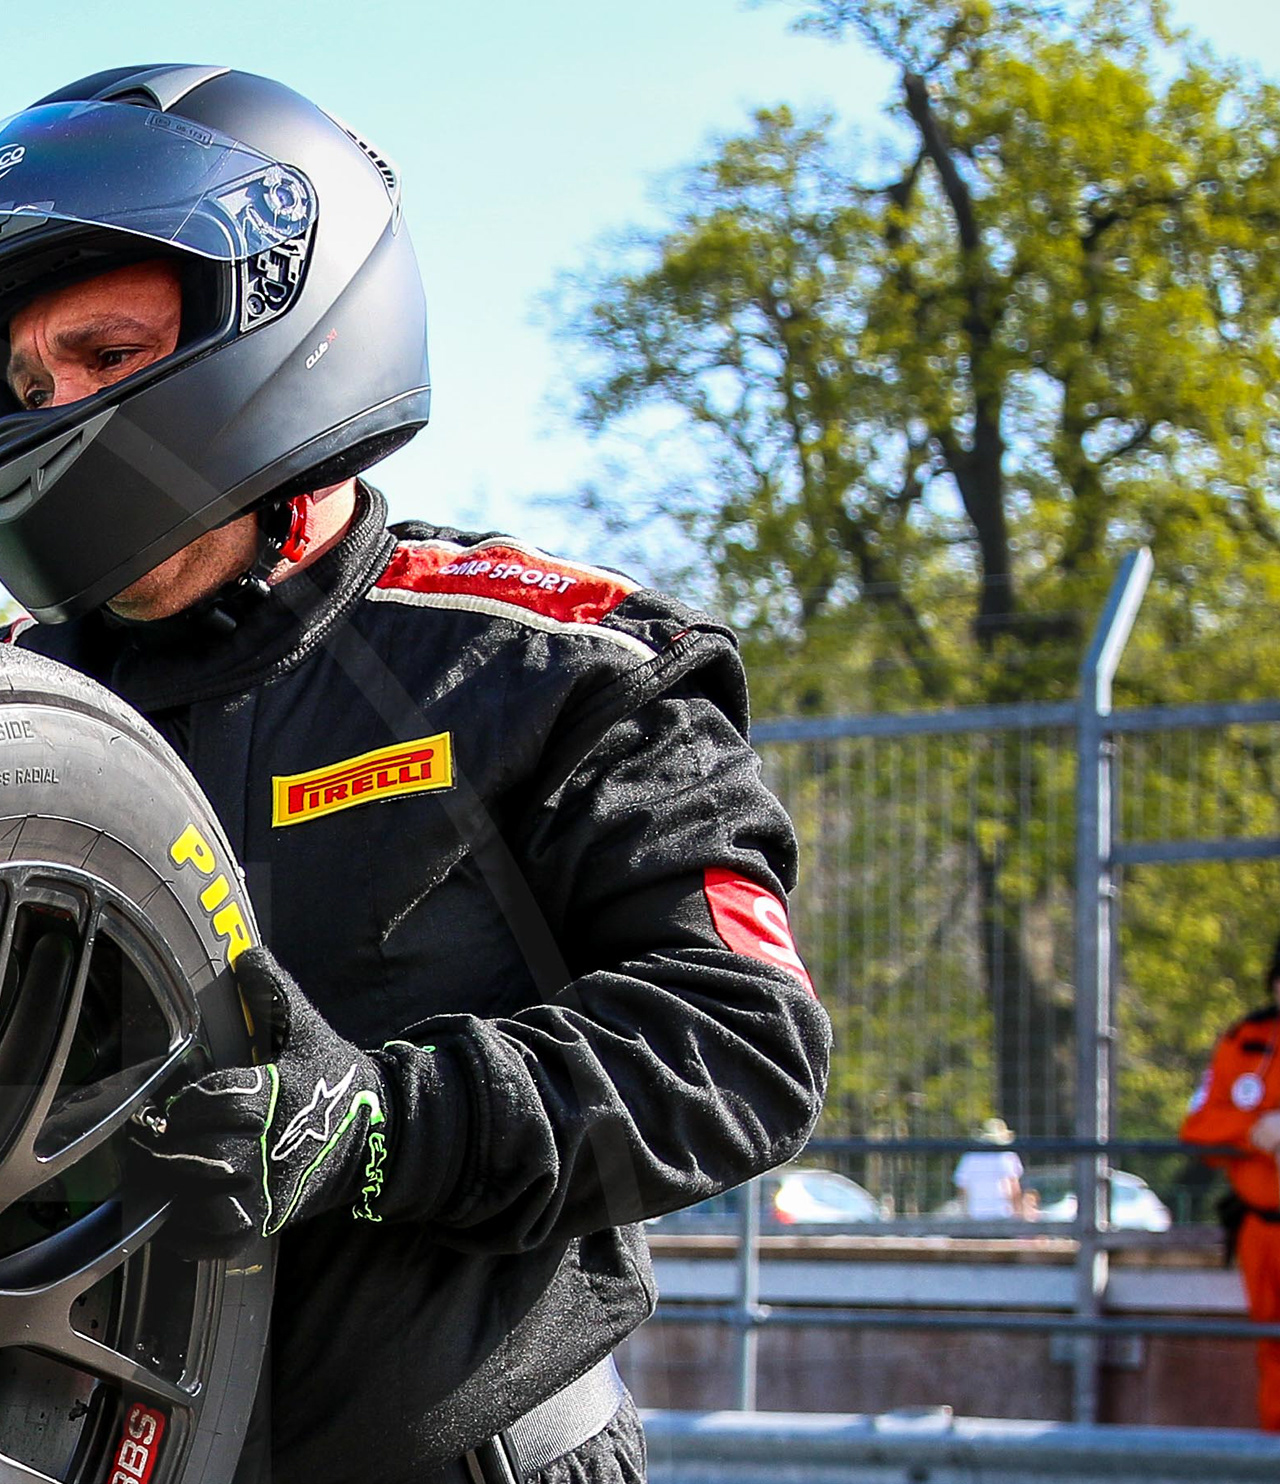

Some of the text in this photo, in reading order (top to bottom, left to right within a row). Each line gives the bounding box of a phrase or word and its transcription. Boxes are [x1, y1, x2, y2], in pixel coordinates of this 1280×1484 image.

[490, 563, 577, 595] SPORT
[14, 766, 60, 787] RADIAL
[287, 748, 434, 815] PIRELLI
